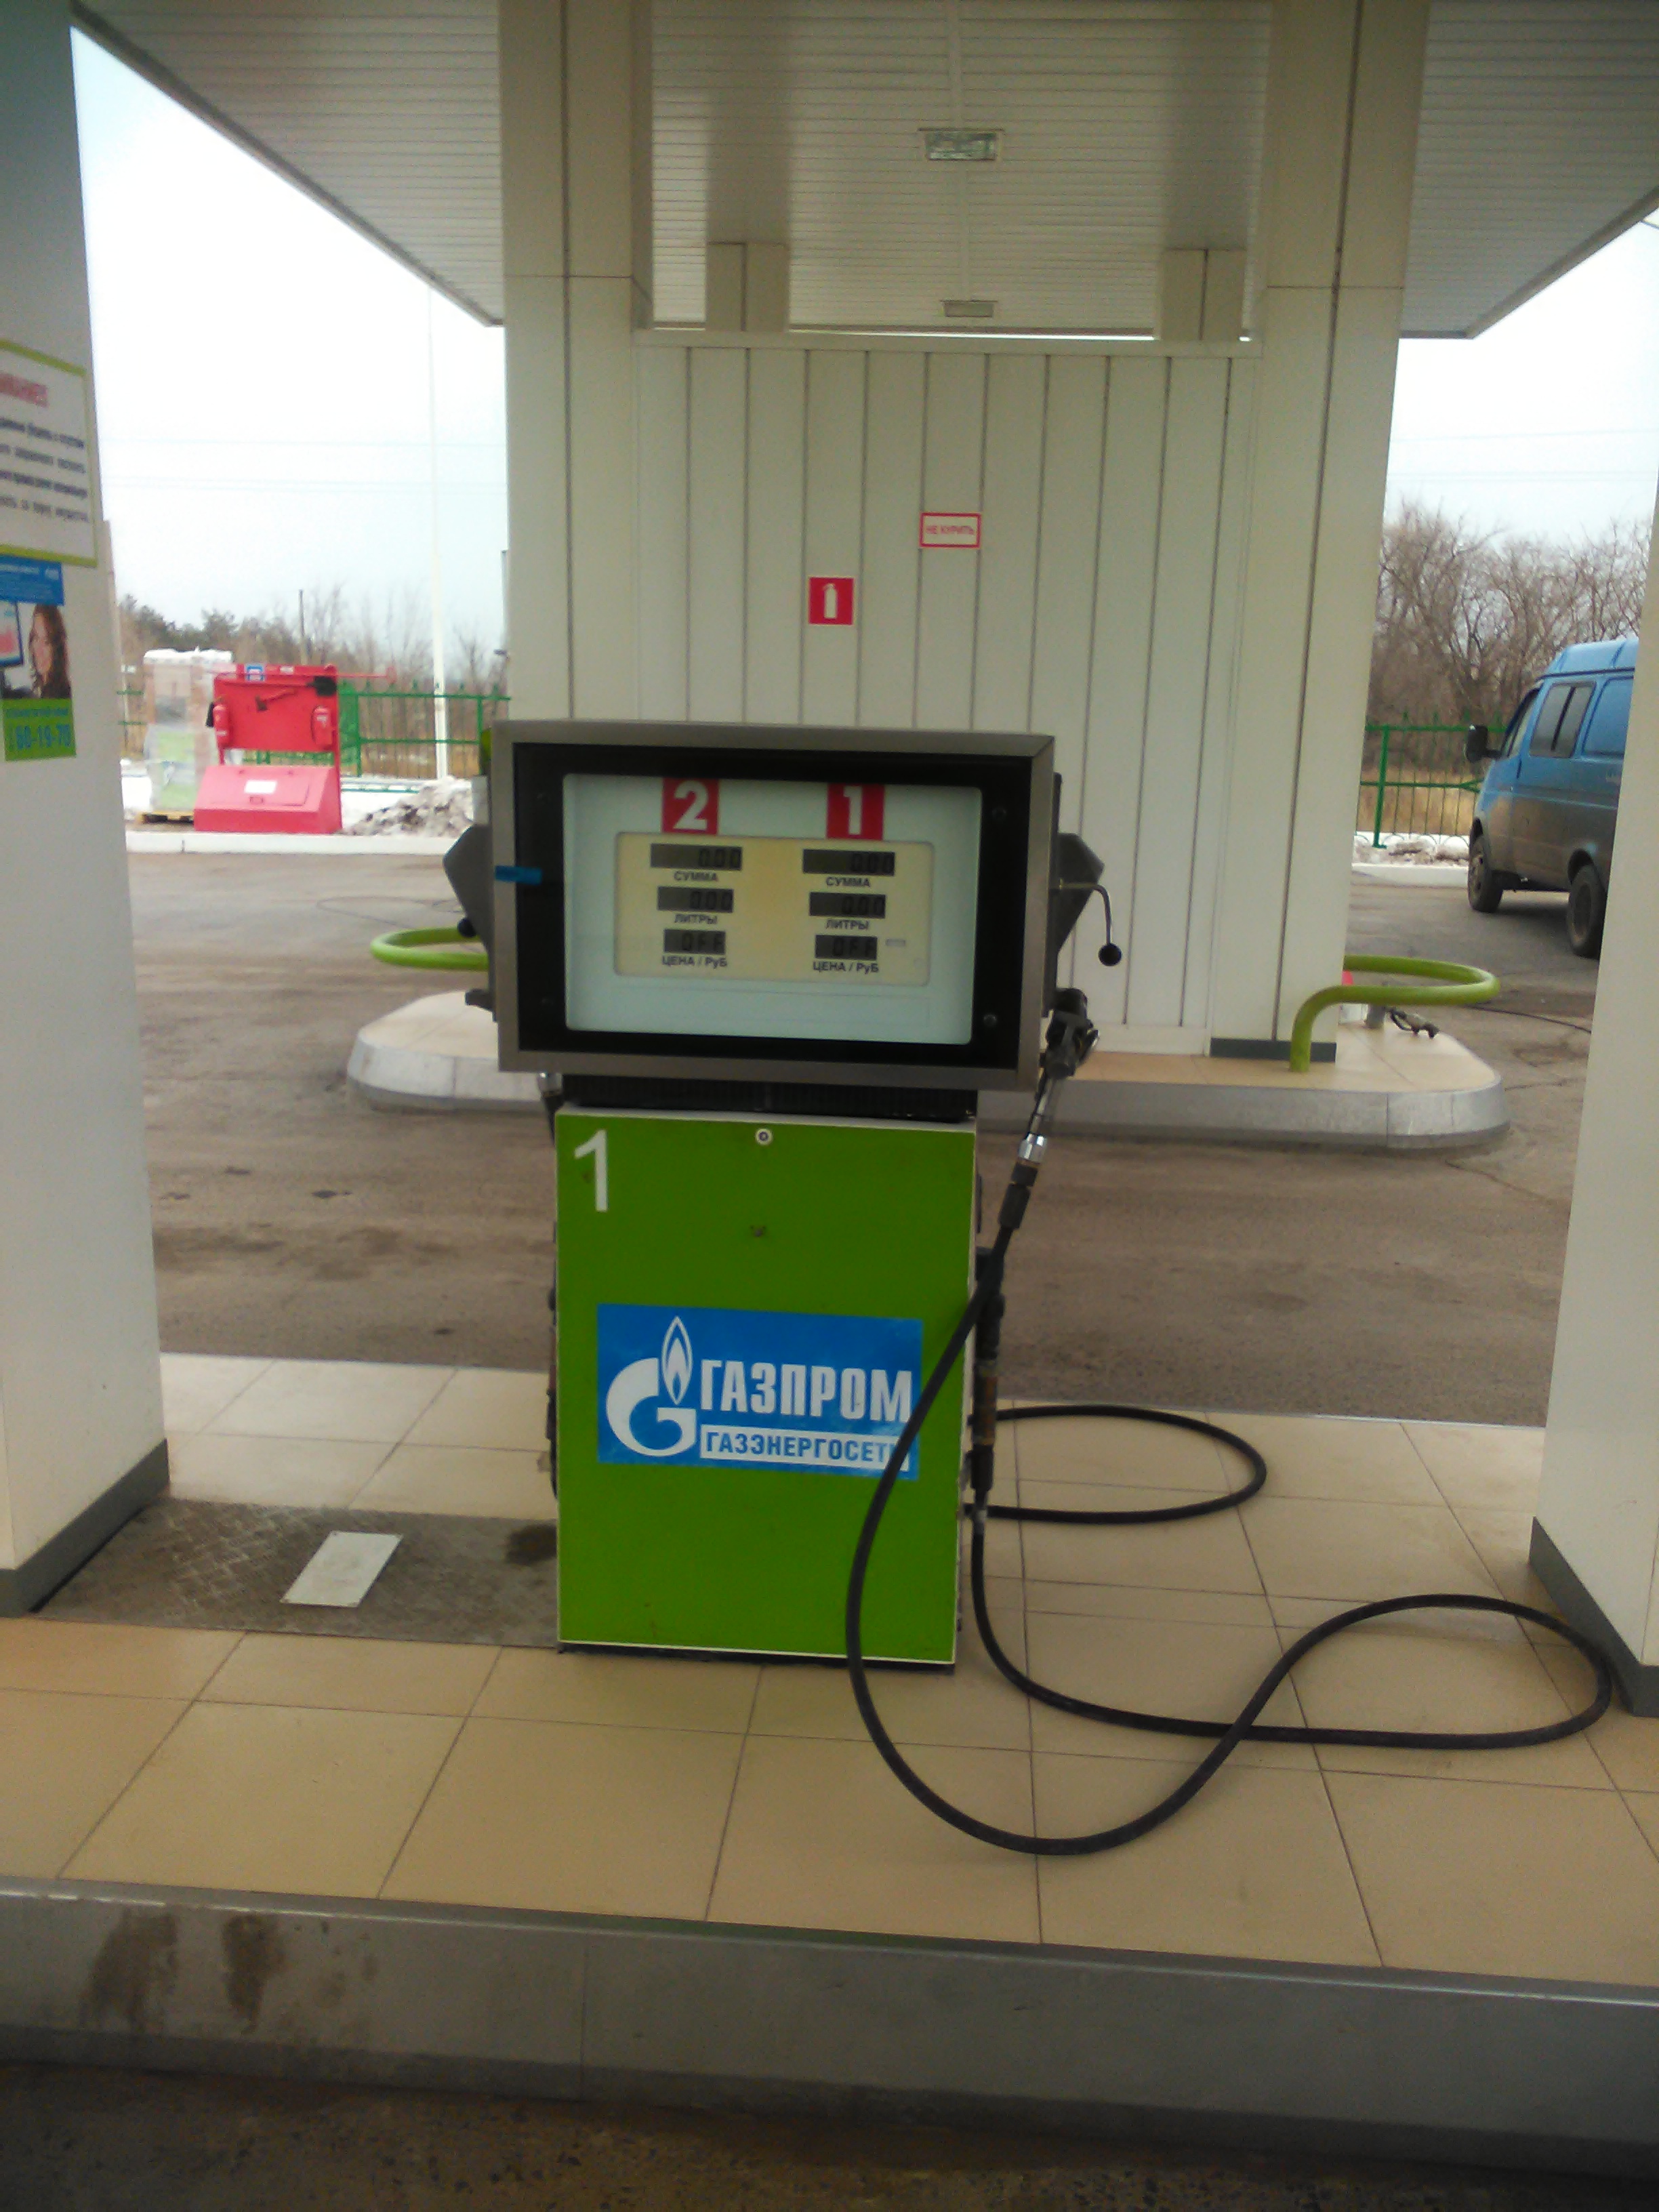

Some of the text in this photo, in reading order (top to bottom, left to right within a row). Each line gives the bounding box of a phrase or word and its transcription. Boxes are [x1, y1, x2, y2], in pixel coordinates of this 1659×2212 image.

[673, 780, 710, 831] 2
[842, 785, 863, 836] 1
[674, 871, 718, 882] СУММА
[825, 876, 871, 888] СУММА
[674, 914, 718, 924] ЛИТРЫ
[825, 919, 869, 930] ЛИТРЫ
[661, 956, 695, 967] ЦЕНА
[813, 961, 845, 973] ЦЕНА
[574, 1129, 608, 1212] 1
[700, 1359, 912, 1422] ГАЗПРОМ
